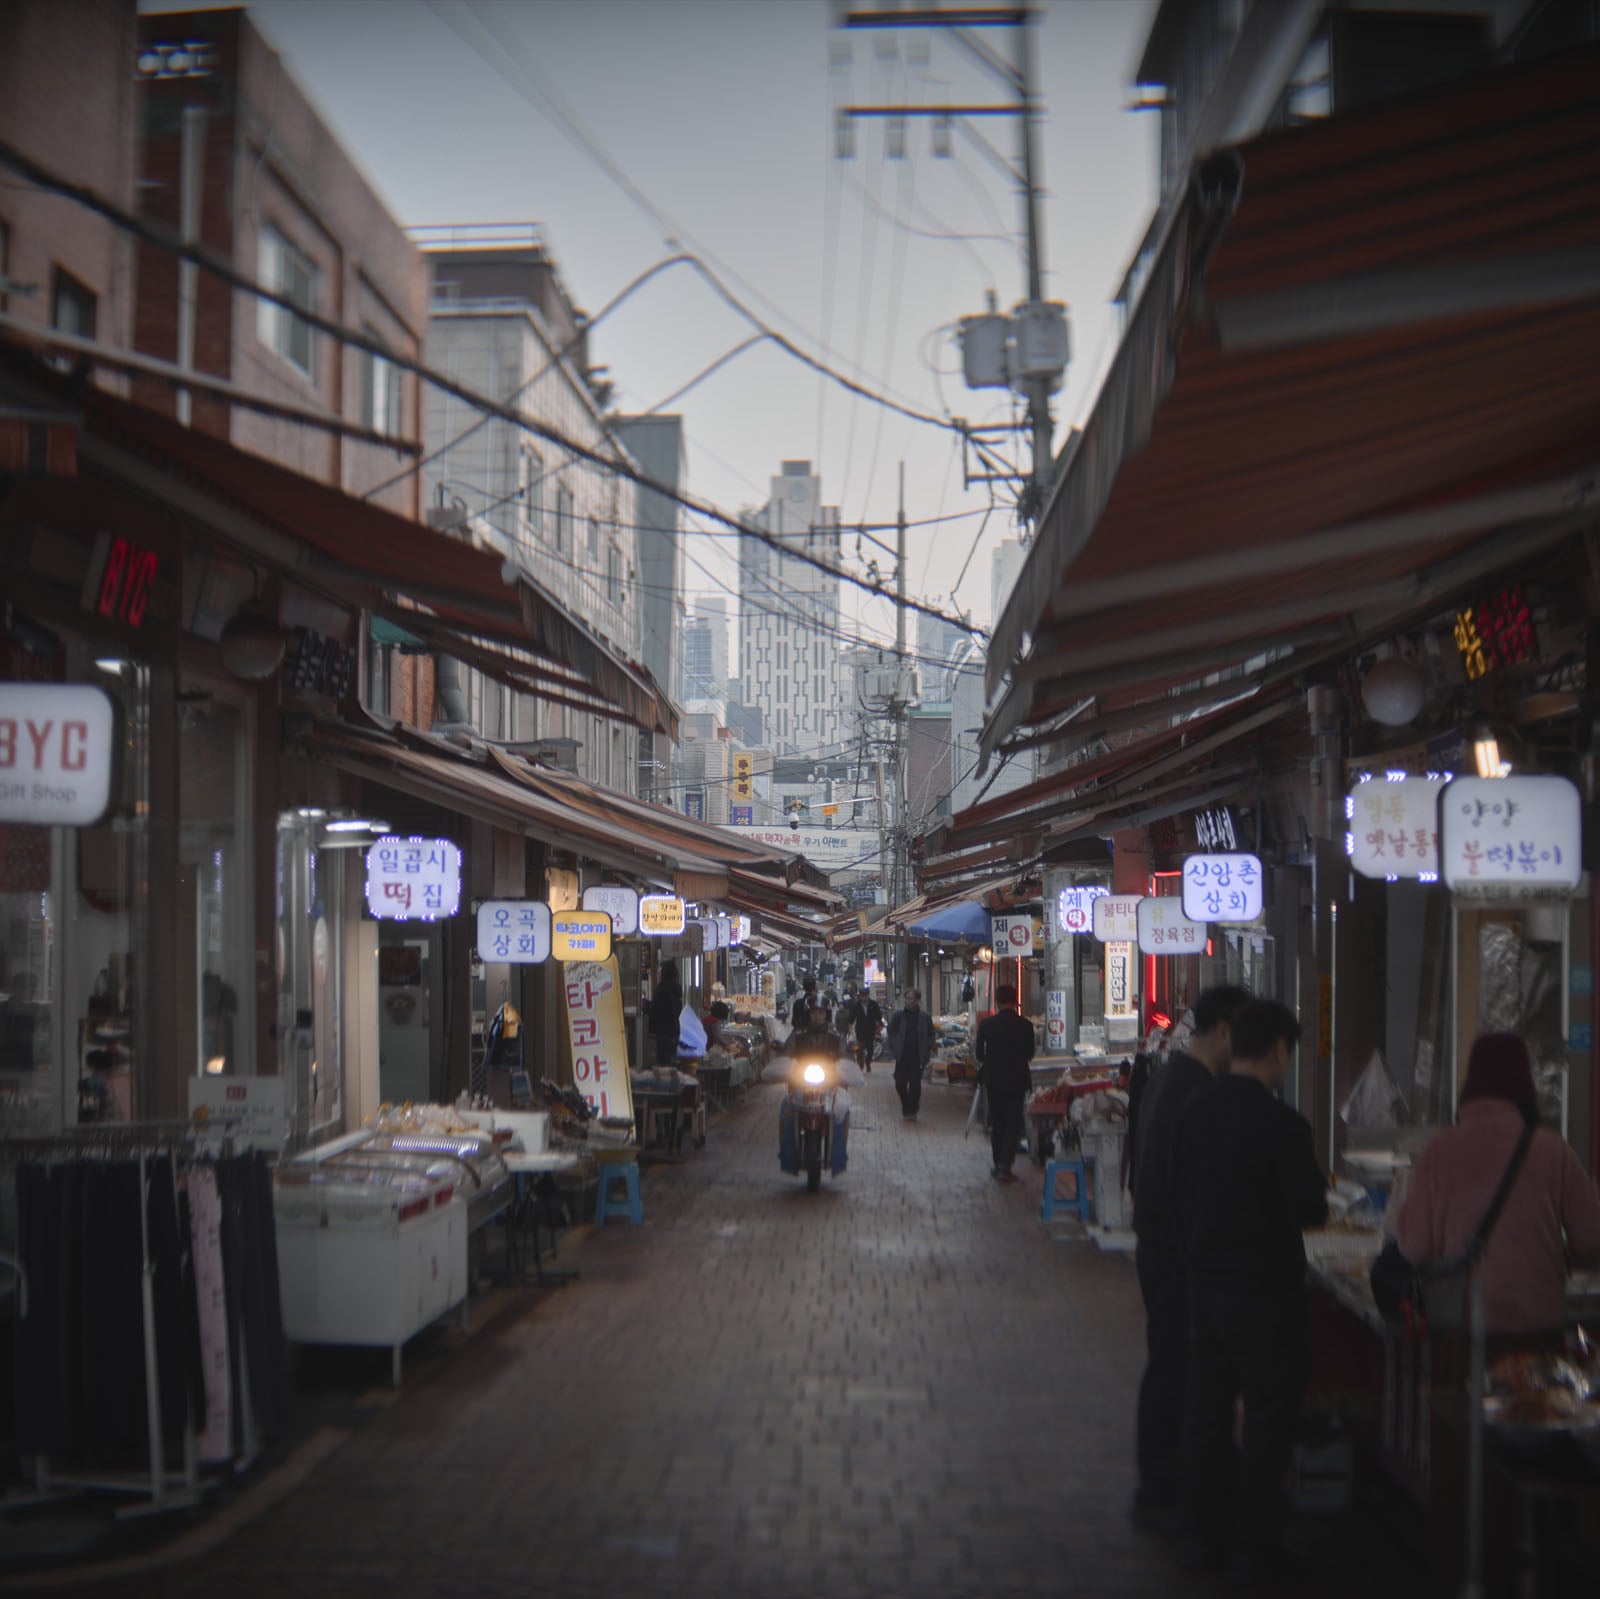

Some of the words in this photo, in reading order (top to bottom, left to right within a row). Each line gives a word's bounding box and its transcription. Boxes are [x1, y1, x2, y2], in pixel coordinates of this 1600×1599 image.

[0, 719, 88, 772] BYC
[32, 783, 77, 803] Shop
[1461, 797, 1521, 827] 양양
[1366, 828, 1439, 859] 옛날통
[379, 848, 446, 874] 일곱시
[1187, 861, 1258, 887] 신앙촌
[383, 882, 442, 910] 떡집
[1203, 890, 1248, 914] 상회
[493, 908, 536, 931] 오곡
[555, 922, 607, 935] 타코야끼
[493, 934, 536, 957] 상회
[568, 938, 596, 950] 카페
[994, 917, 1009, 955] 제일
[1152, 927, 1195, 945] 정육점
